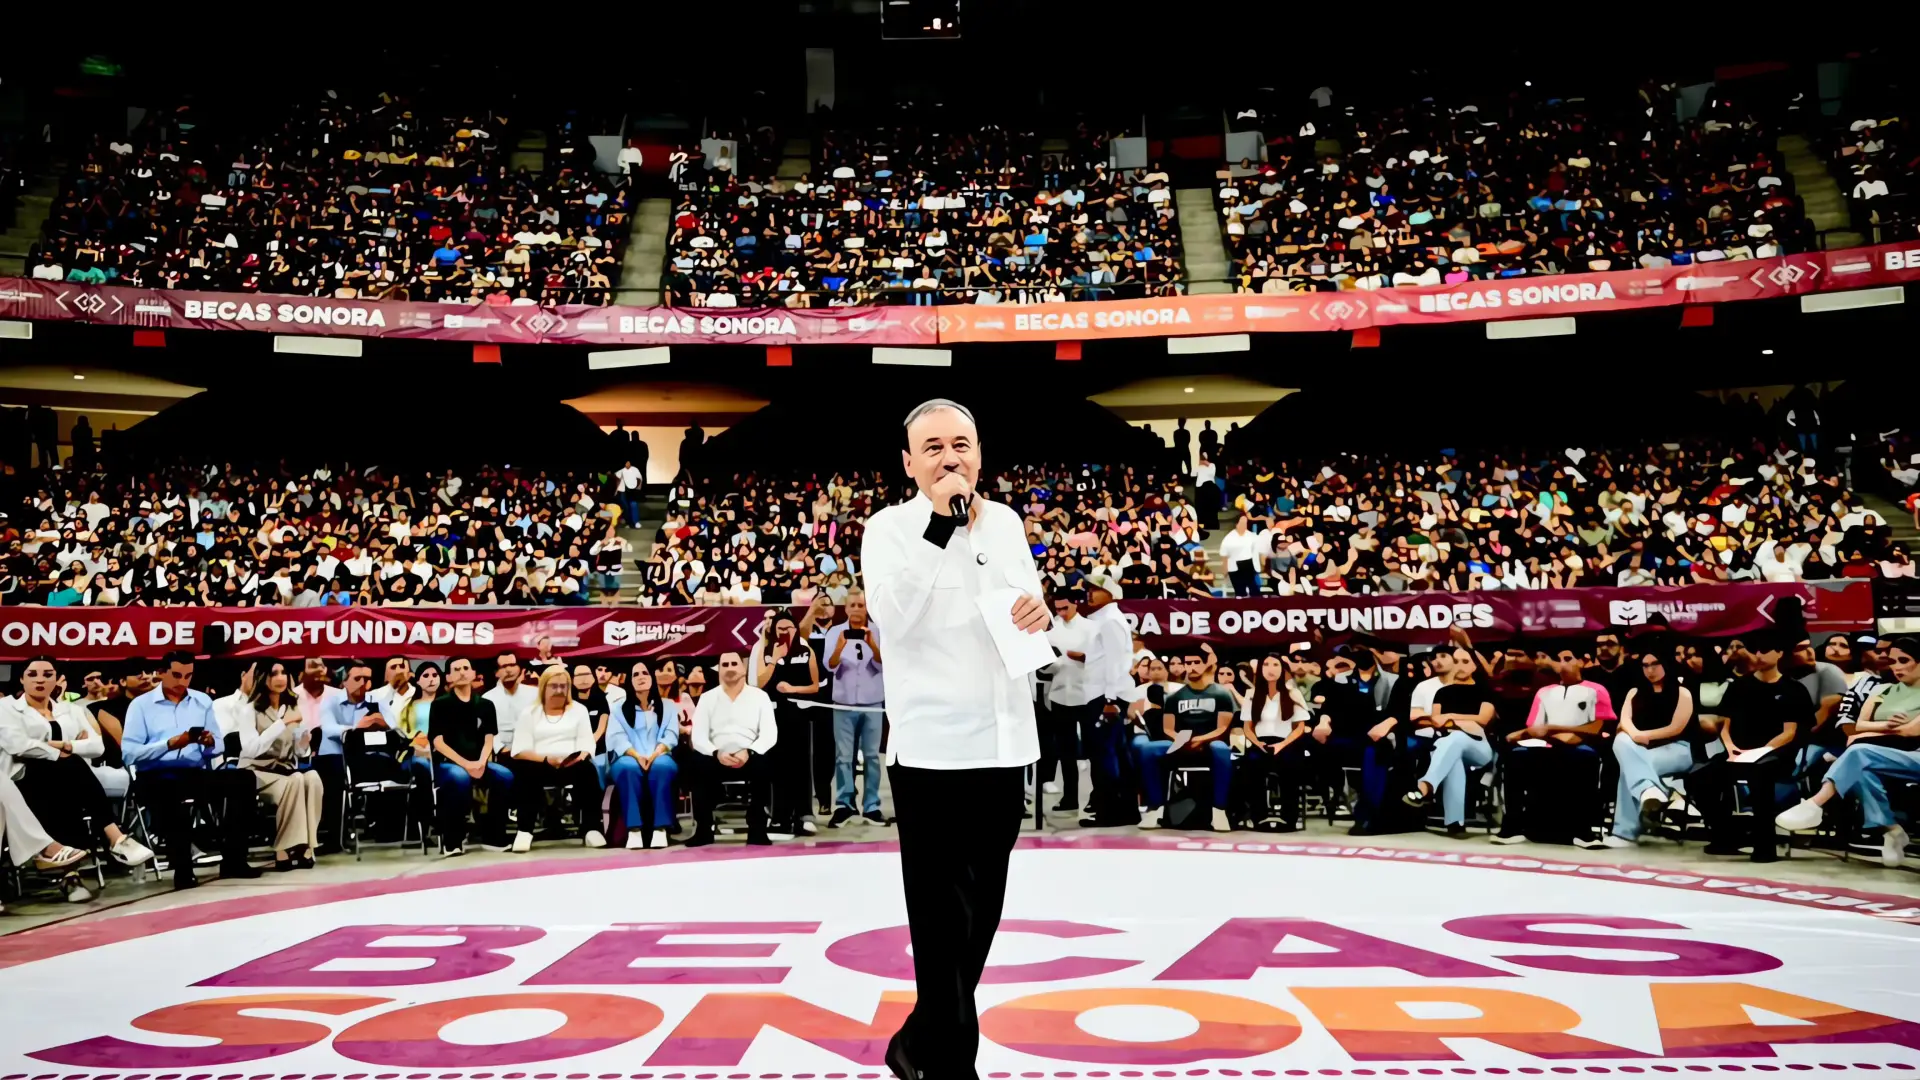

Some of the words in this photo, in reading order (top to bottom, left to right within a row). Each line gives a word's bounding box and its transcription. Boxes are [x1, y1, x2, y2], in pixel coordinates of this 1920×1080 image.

[1419, 289, 1502, 312] BECAS
[1507, 281, 1616, 306] SONORA
[185, 300, 271, 322] BECAS
[277, 304, 386, 327] SONORA
[619, 316, 695, 334] BECAS
[700, 316, 796, 335] SONORA
[1015, 312, 1089, 330] BECAS
[1095, 307, 1191, 328] SONORA
[148, 621, 196, 646] DE
[1169, 611, 1211, 635] DE
[1218, 603, 1494, 635] OPORTUNIDADES
[188, 913, 1783, 987] BECAS
[25, 981, 1920, 1068] SONORA
